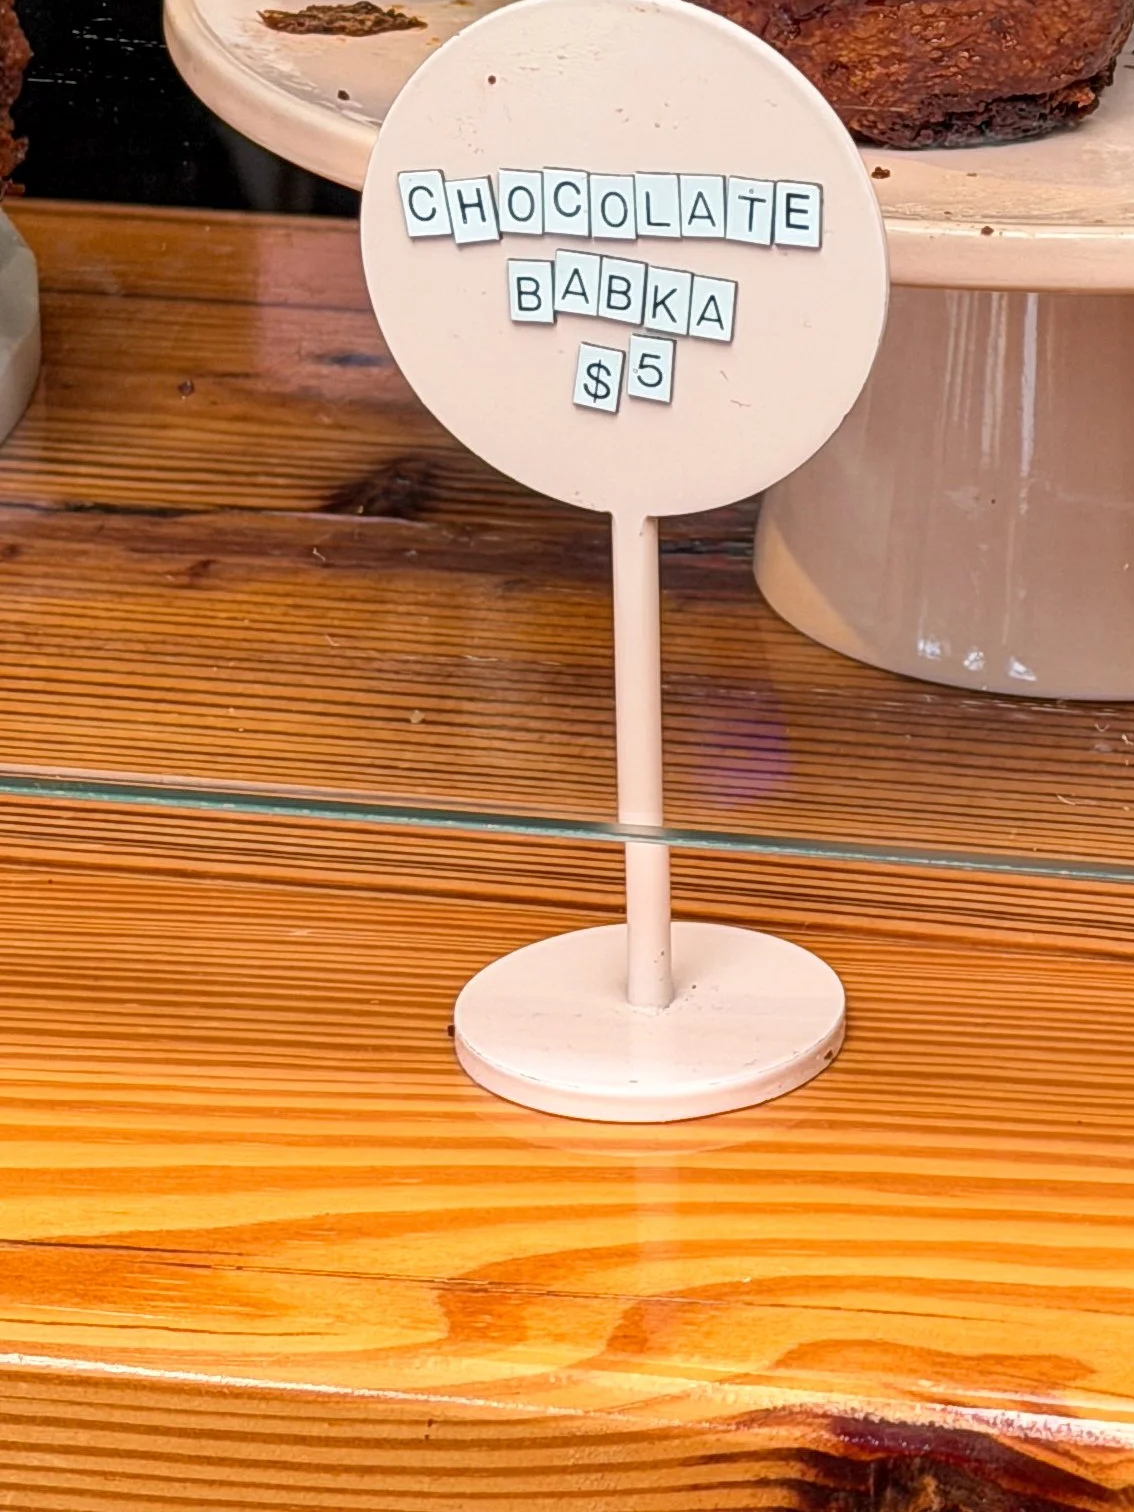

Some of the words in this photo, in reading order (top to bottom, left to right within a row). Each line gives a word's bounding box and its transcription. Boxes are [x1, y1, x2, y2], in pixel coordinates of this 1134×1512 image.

[407, 180, 811, 234] CHOCOLATE
[516, 267, 726, 331] BABKA
[582, 353, 664, 404] $5
